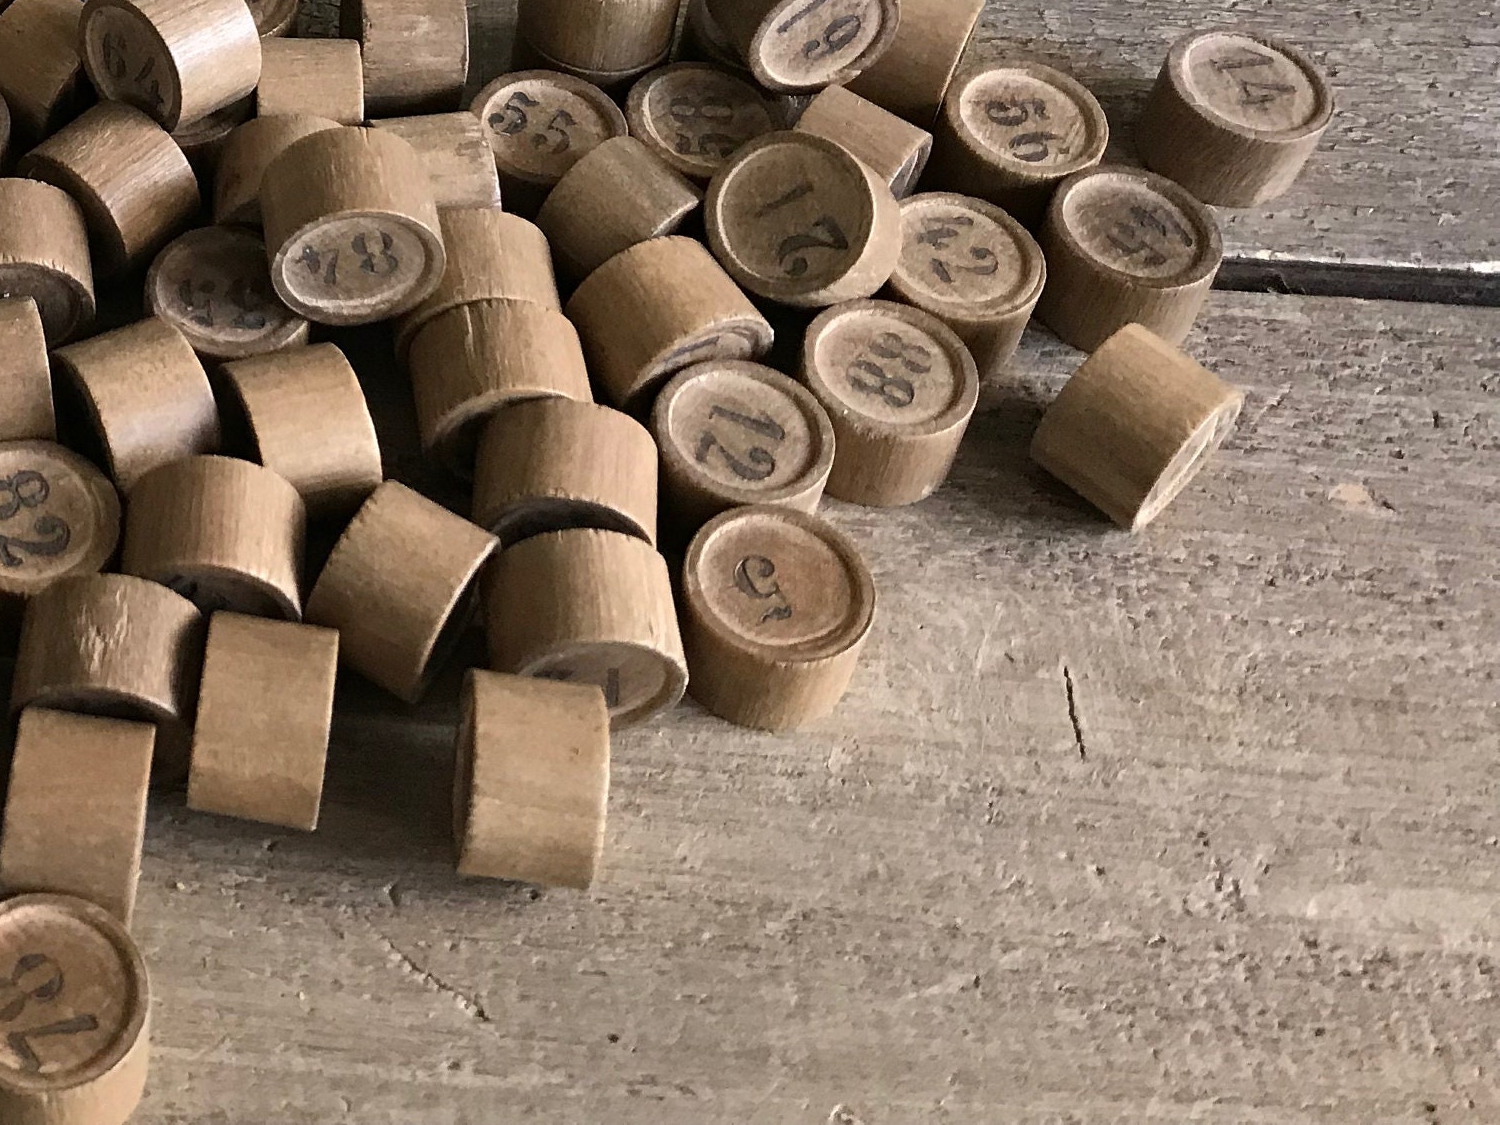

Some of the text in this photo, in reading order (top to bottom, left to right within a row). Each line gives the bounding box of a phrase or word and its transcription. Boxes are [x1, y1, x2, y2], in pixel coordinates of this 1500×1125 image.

[488, 90, 577, 155] 55
[845, 331, 932, 409] 88
[733, 554, 792, 626] 5
